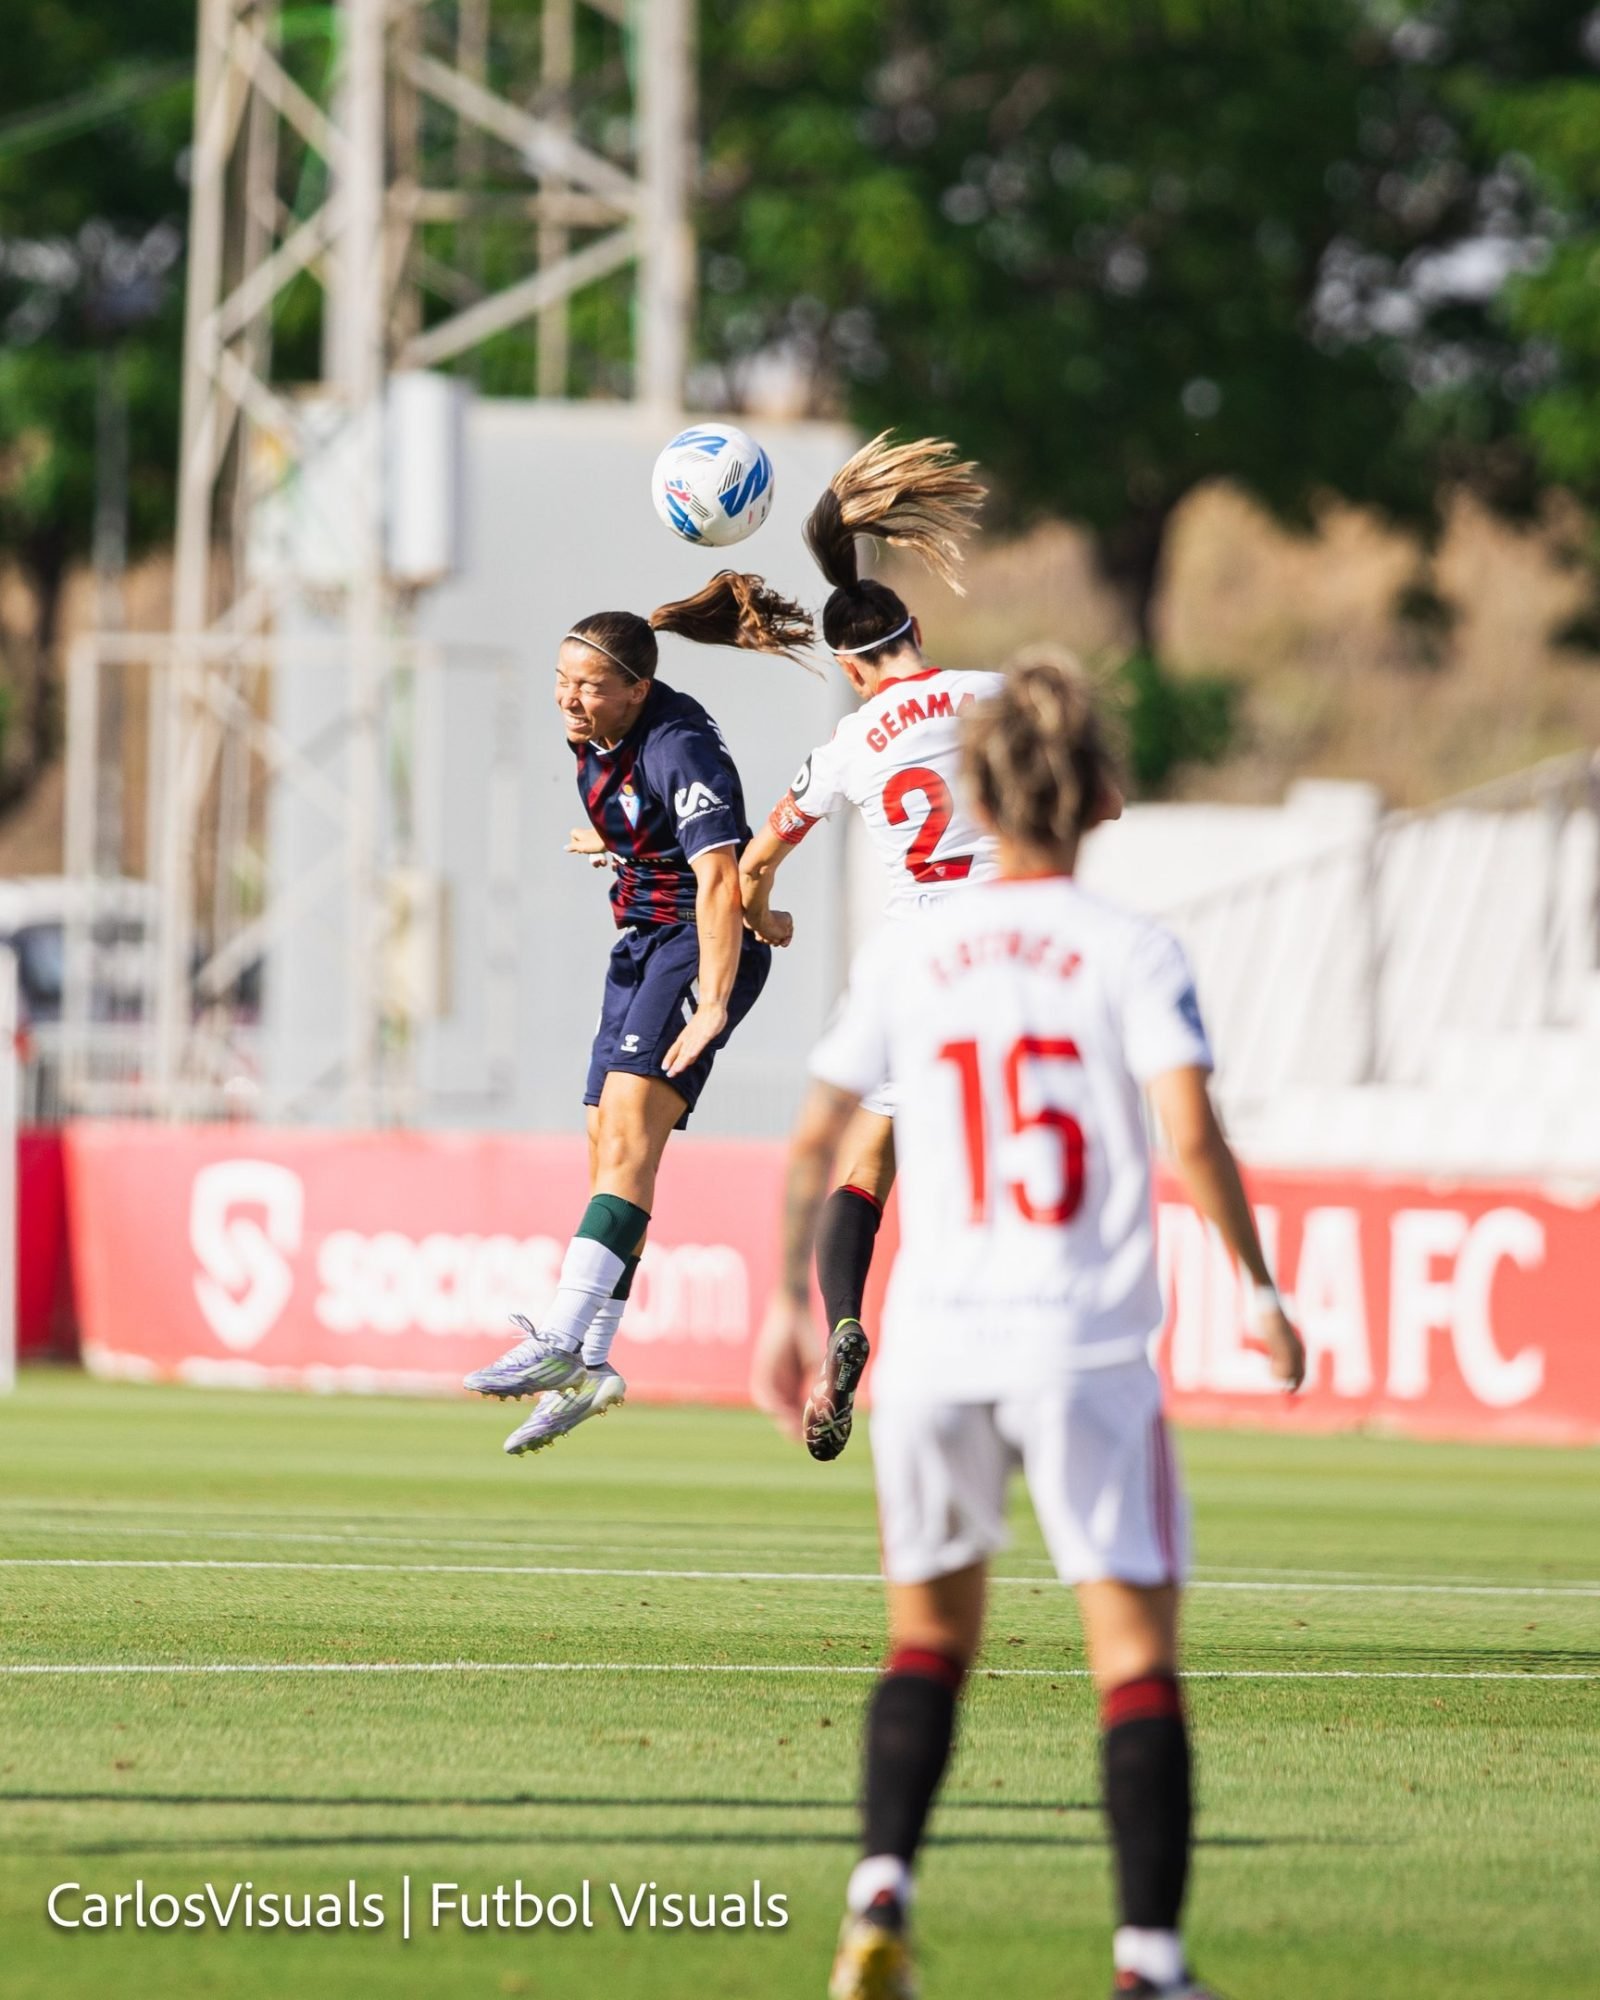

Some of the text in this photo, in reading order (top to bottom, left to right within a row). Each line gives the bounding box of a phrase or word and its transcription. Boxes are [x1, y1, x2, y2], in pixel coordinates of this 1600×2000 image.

[881, 767, 974, 883] 2
[938, 1034, 1085, 1227] 15
[1386, 1207, 1546, 1407] FC
